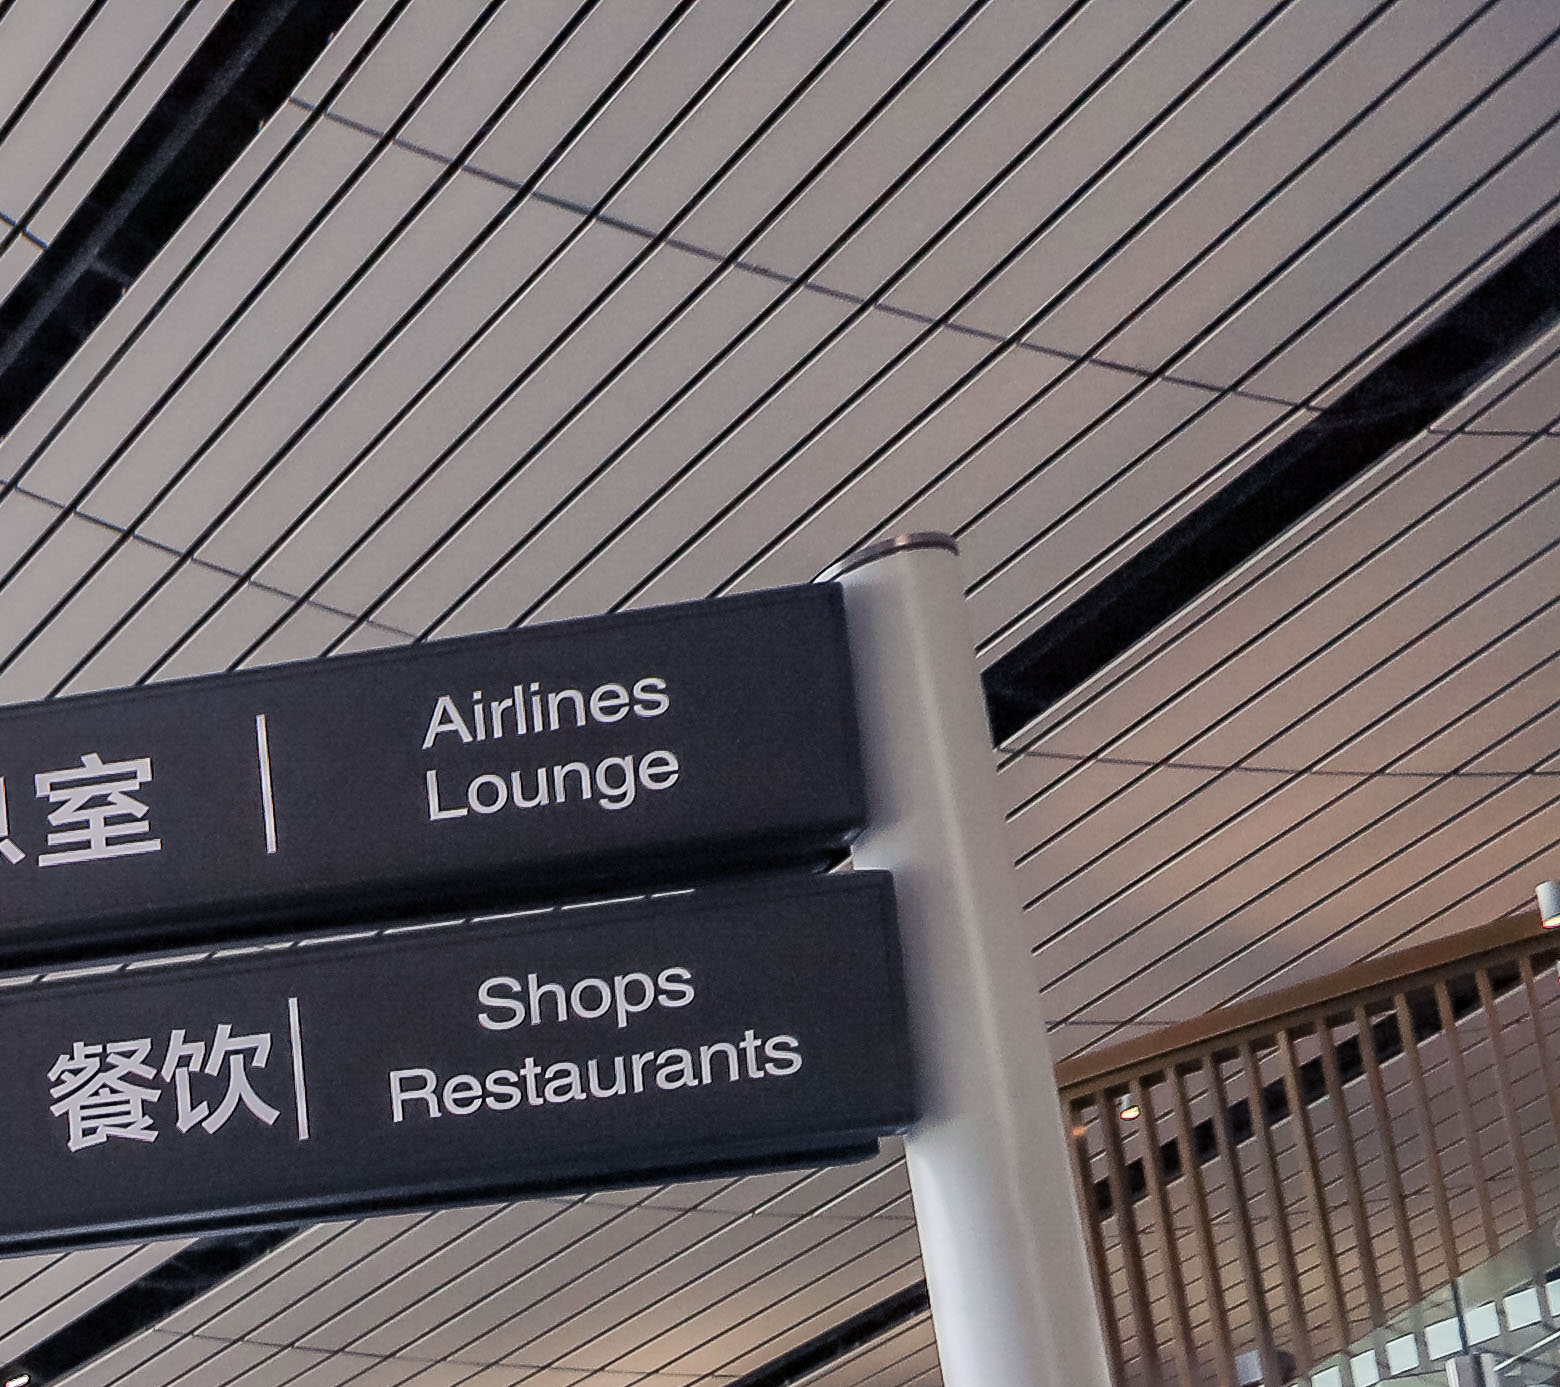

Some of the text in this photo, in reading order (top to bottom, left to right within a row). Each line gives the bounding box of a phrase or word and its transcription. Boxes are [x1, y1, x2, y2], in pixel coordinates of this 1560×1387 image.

[422, 675, 671, 748] Airlines
[424, 737, 681, 822] Lounge
[477, 958, 696, 1034] Shops
[389, 1030, 804, 1123] Restaurants
